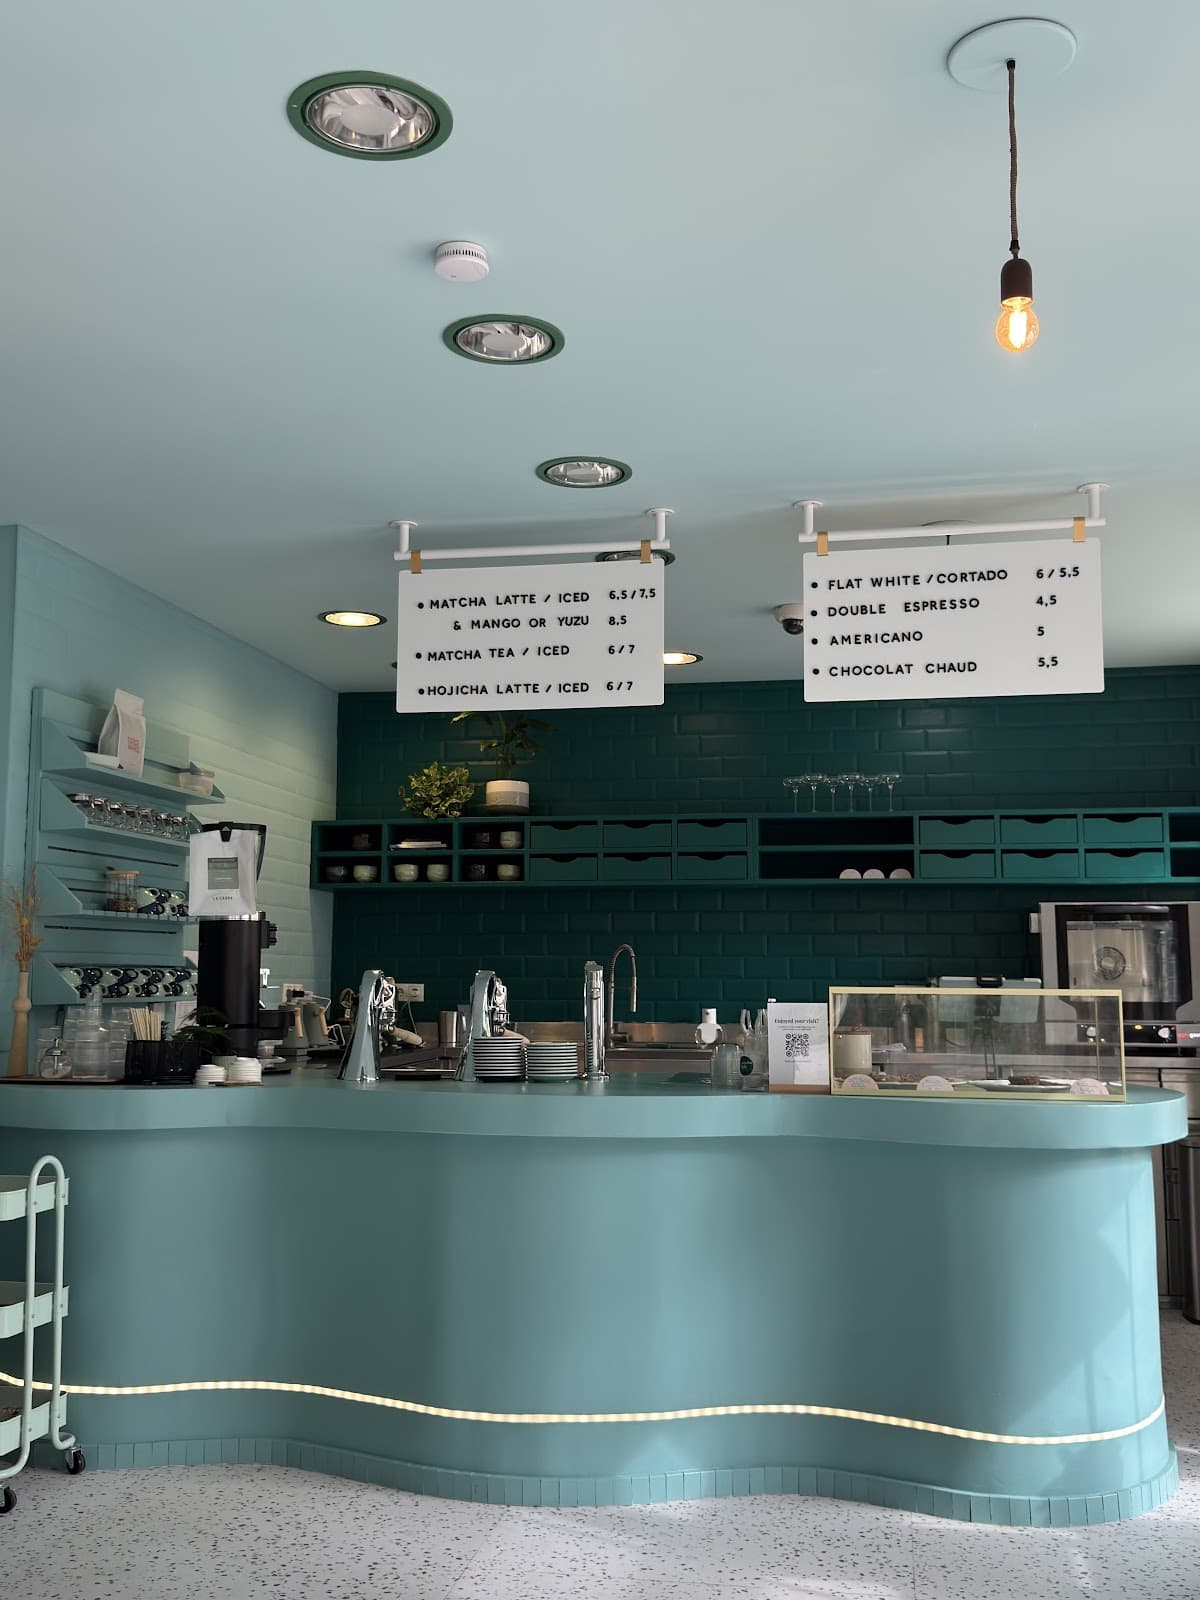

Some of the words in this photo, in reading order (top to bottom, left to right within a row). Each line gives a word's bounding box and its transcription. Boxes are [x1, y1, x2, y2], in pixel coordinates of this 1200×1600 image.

[828, 578, 863, 591] FLAT
[870, 574, 921, 588] WHITE
[429, 596, 487, 610] MATCHA
[495, 594, 537, 606] LATTE
[558, 592, 590, 604] ICED
[827, 604, 887, 618] DOUBLE
[903, 597, 980, 613] ESPRESSO
[452, 621, 462, 631] &
[470, 618, 521, 631] MANGO
[528, 618, 547, 629] OR
[557, 615, 590, 627] YUZU
[829, 630, 923, 647] AMERICANO
[1036, 626, 1045, 637] 5
[427, 649, 482, 662] MATCHA
[487, 647, 515, 659] TEA
[537, 645, 570, 657] ICED
[828, 663, 914, 677] CHOCOLAT
[924, 661, 978, 674] CHAUD
[427, 683, 489, 696] HOJICHA
[496, 683, 540, 695] LATTE
[558, 682, 590, 694] ICED
